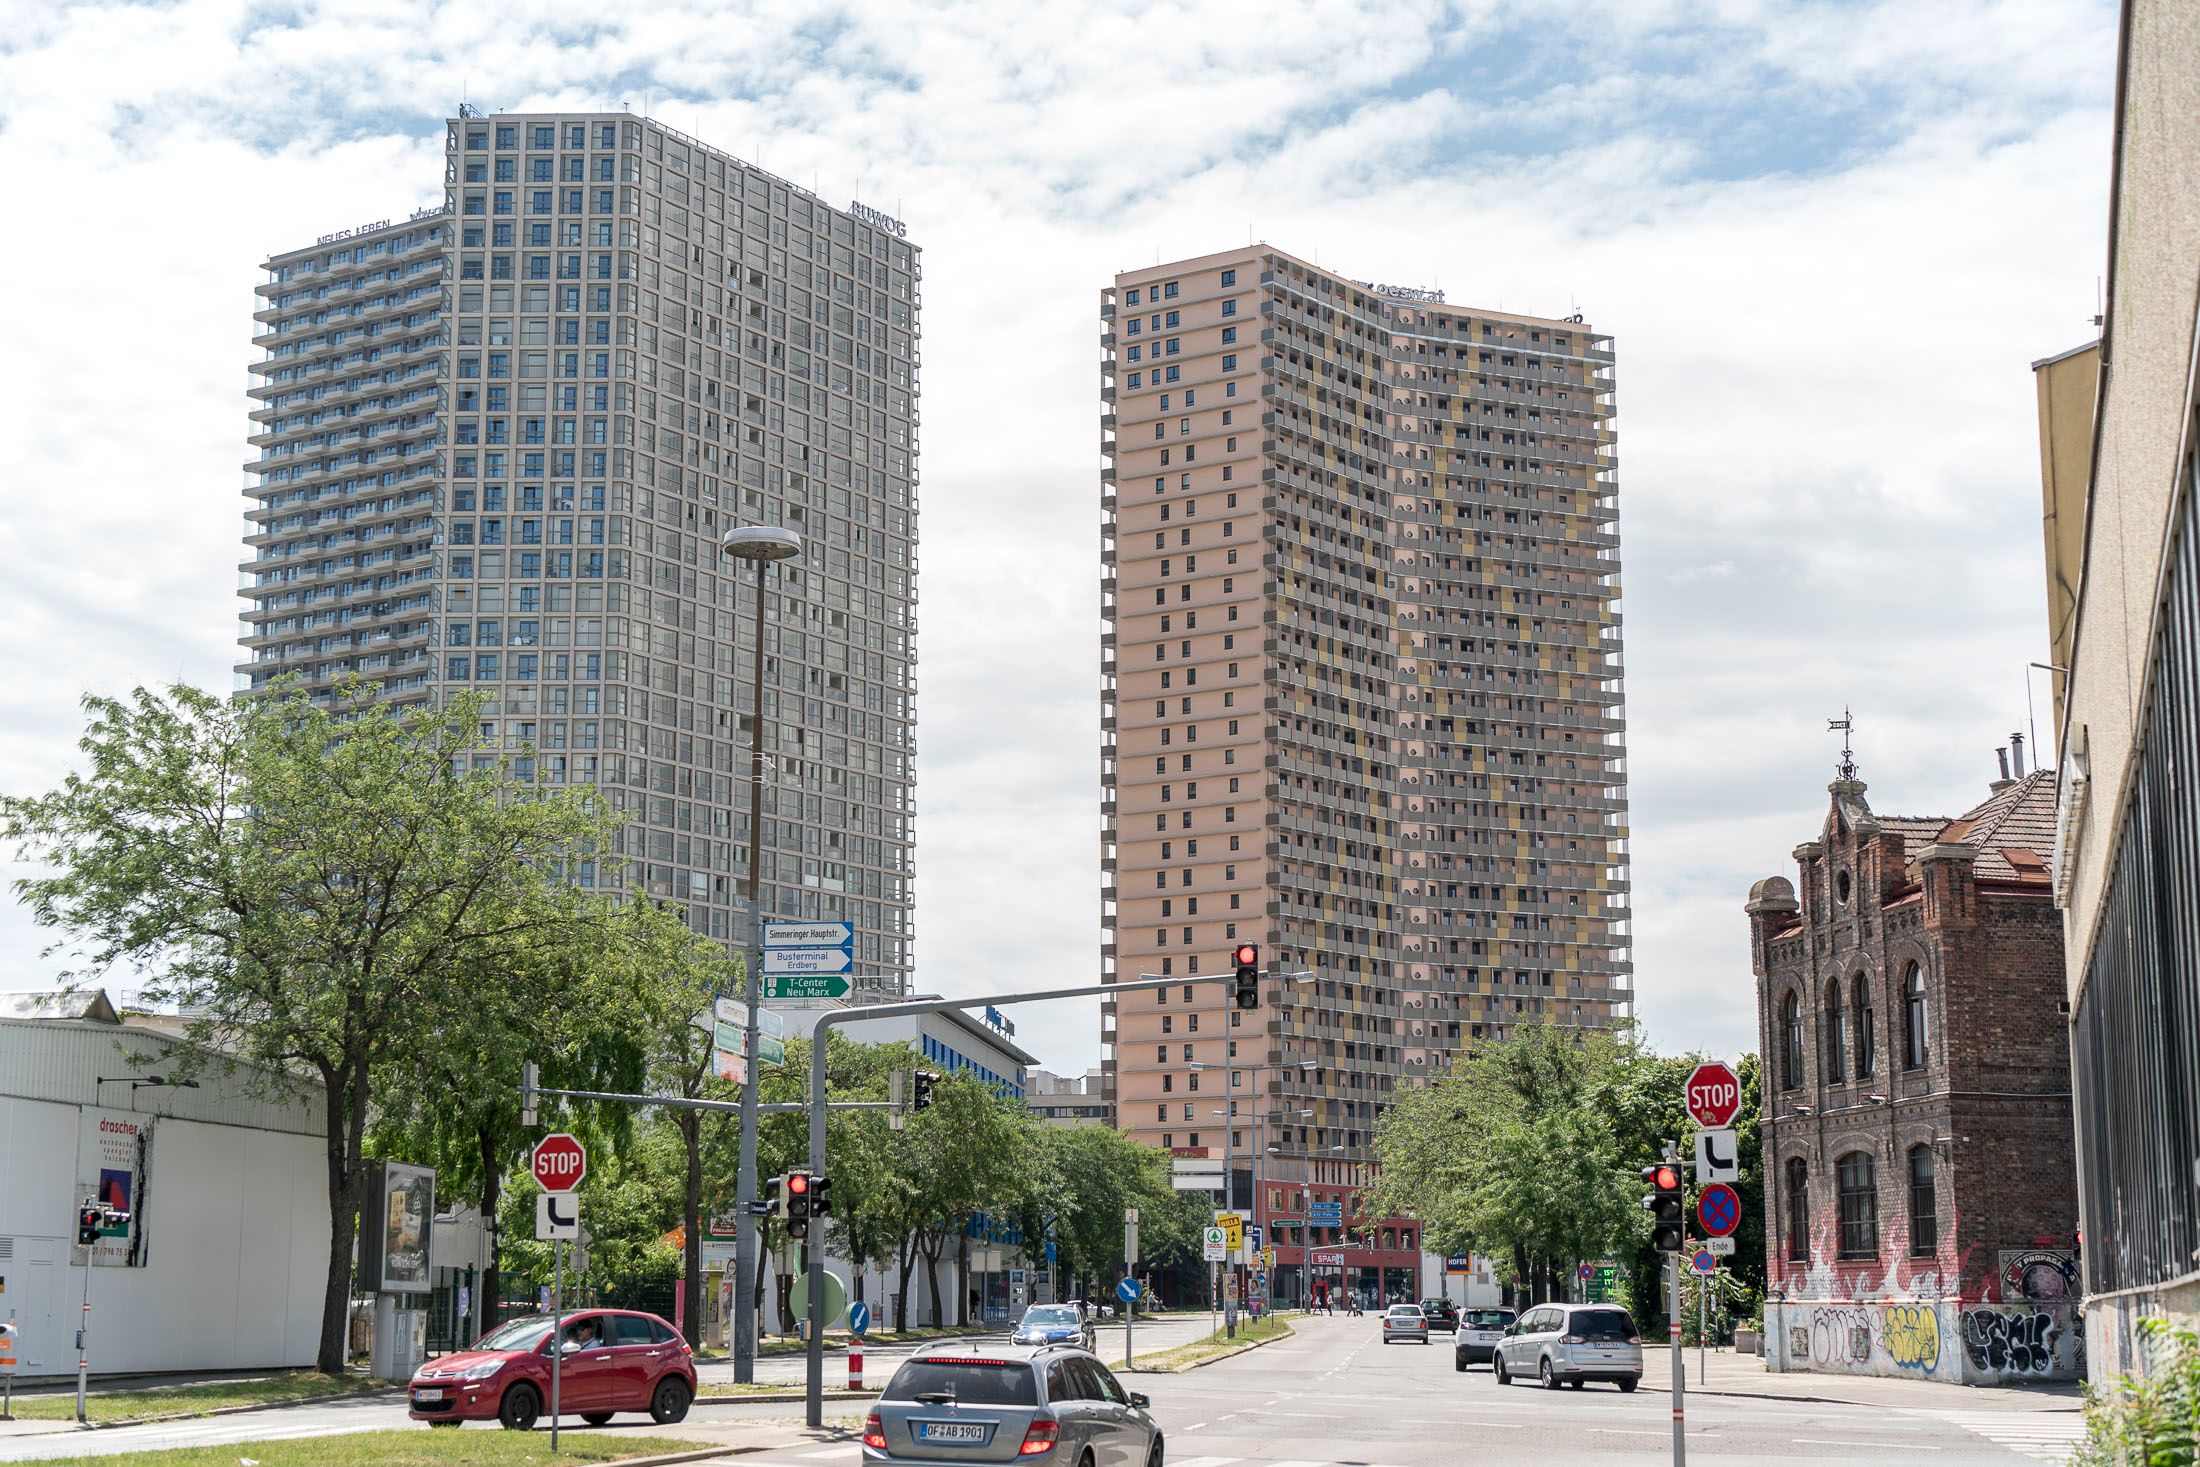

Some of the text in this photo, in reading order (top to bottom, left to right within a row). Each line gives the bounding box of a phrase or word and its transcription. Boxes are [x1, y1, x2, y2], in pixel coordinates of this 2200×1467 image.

[852, 200, 907, 238] BUWOG
[317, 229, 352, 245] NEUES
[777, 952, 829, 961] Busterminal
[787, 961, 818, 971] Erdberg
[790, 978, 829, 988] T-Center
[786, 987, 830, 997] Neu Marx
[1691, 1084, 1735, 1110] STOP
[538, 1151, 580, 1176] STOP
[1712, 1241, 1729, 1251] Ende
[1317, 1254, 1337, 1263] SPAR
[927, 1425, 982, 1439] OF AB 1901
